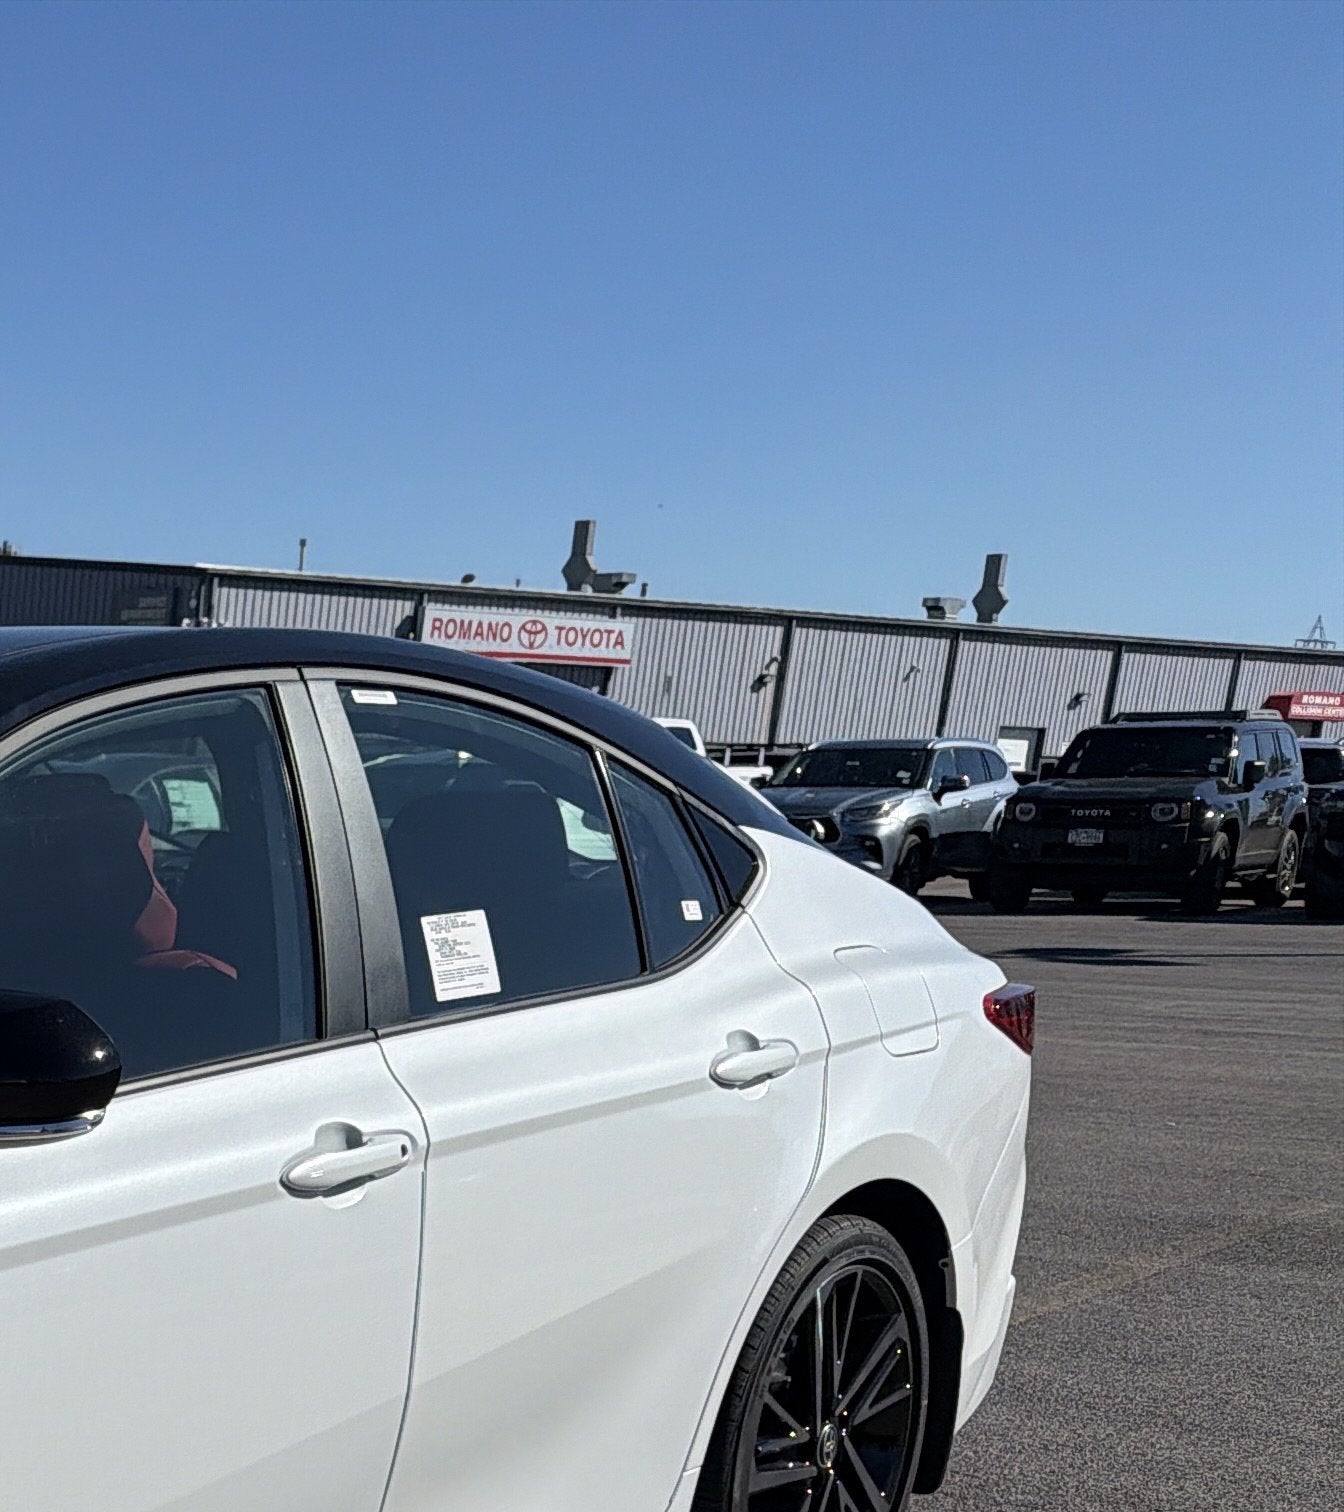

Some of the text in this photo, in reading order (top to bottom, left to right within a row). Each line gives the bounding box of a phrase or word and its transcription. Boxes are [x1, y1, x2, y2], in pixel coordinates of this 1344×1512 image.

[430, 617, 625, 650] ROMANO TOYOTA
[1302, 694, 1341, 706] ROMANO
